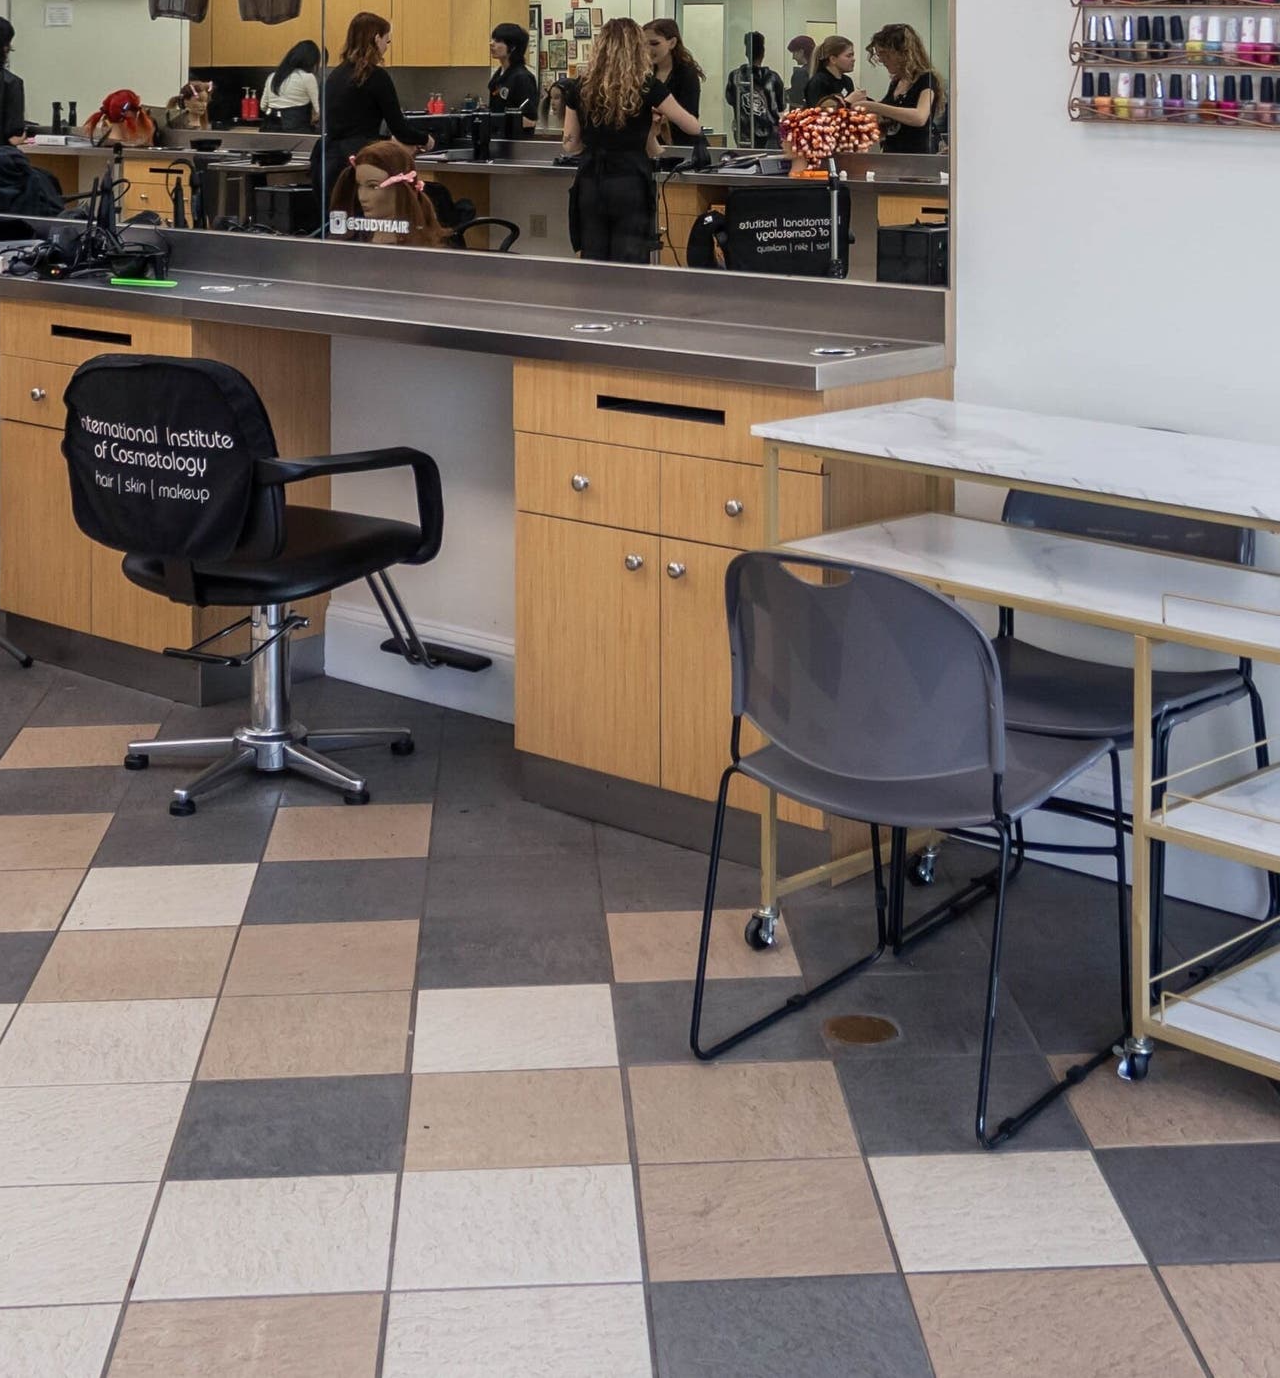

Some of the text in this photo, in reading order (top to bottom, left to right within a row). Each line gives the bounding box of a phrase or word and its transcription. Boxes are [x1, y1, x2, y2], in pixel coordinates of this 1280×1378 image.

[347, 217, 410, 234] @STUDYHAIR
[81, 415, 234, 450] nternational Institute
[94, 440, 207, 477] of Cosmetology
[95, 470, 210, 504] hair skin makeup
